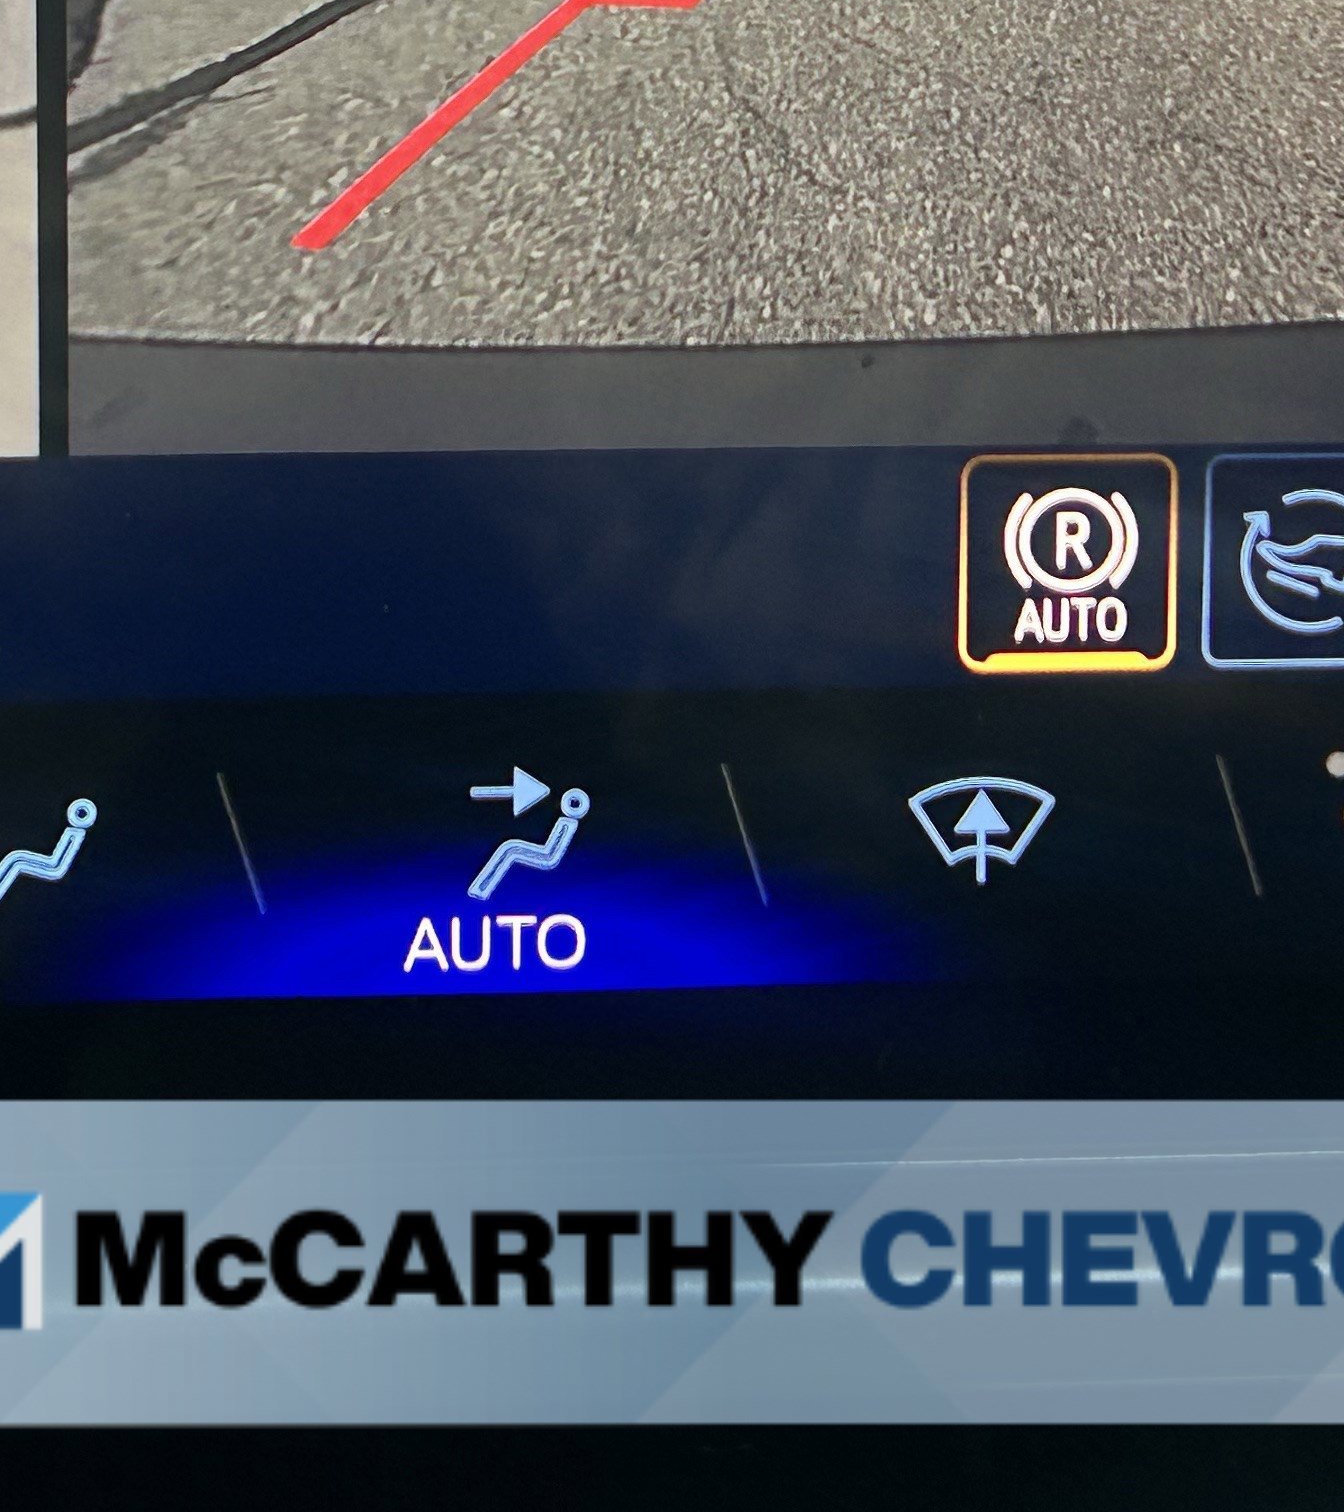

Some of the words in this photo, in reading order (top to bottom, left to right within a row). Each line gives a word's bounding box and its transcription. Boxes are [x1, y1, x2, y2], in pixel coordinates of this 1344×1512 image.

[1054, 509, 1092, 572] R
[1013, 595, 1129, 645] AUTO
[402, 912, 589, 974] AUTO
